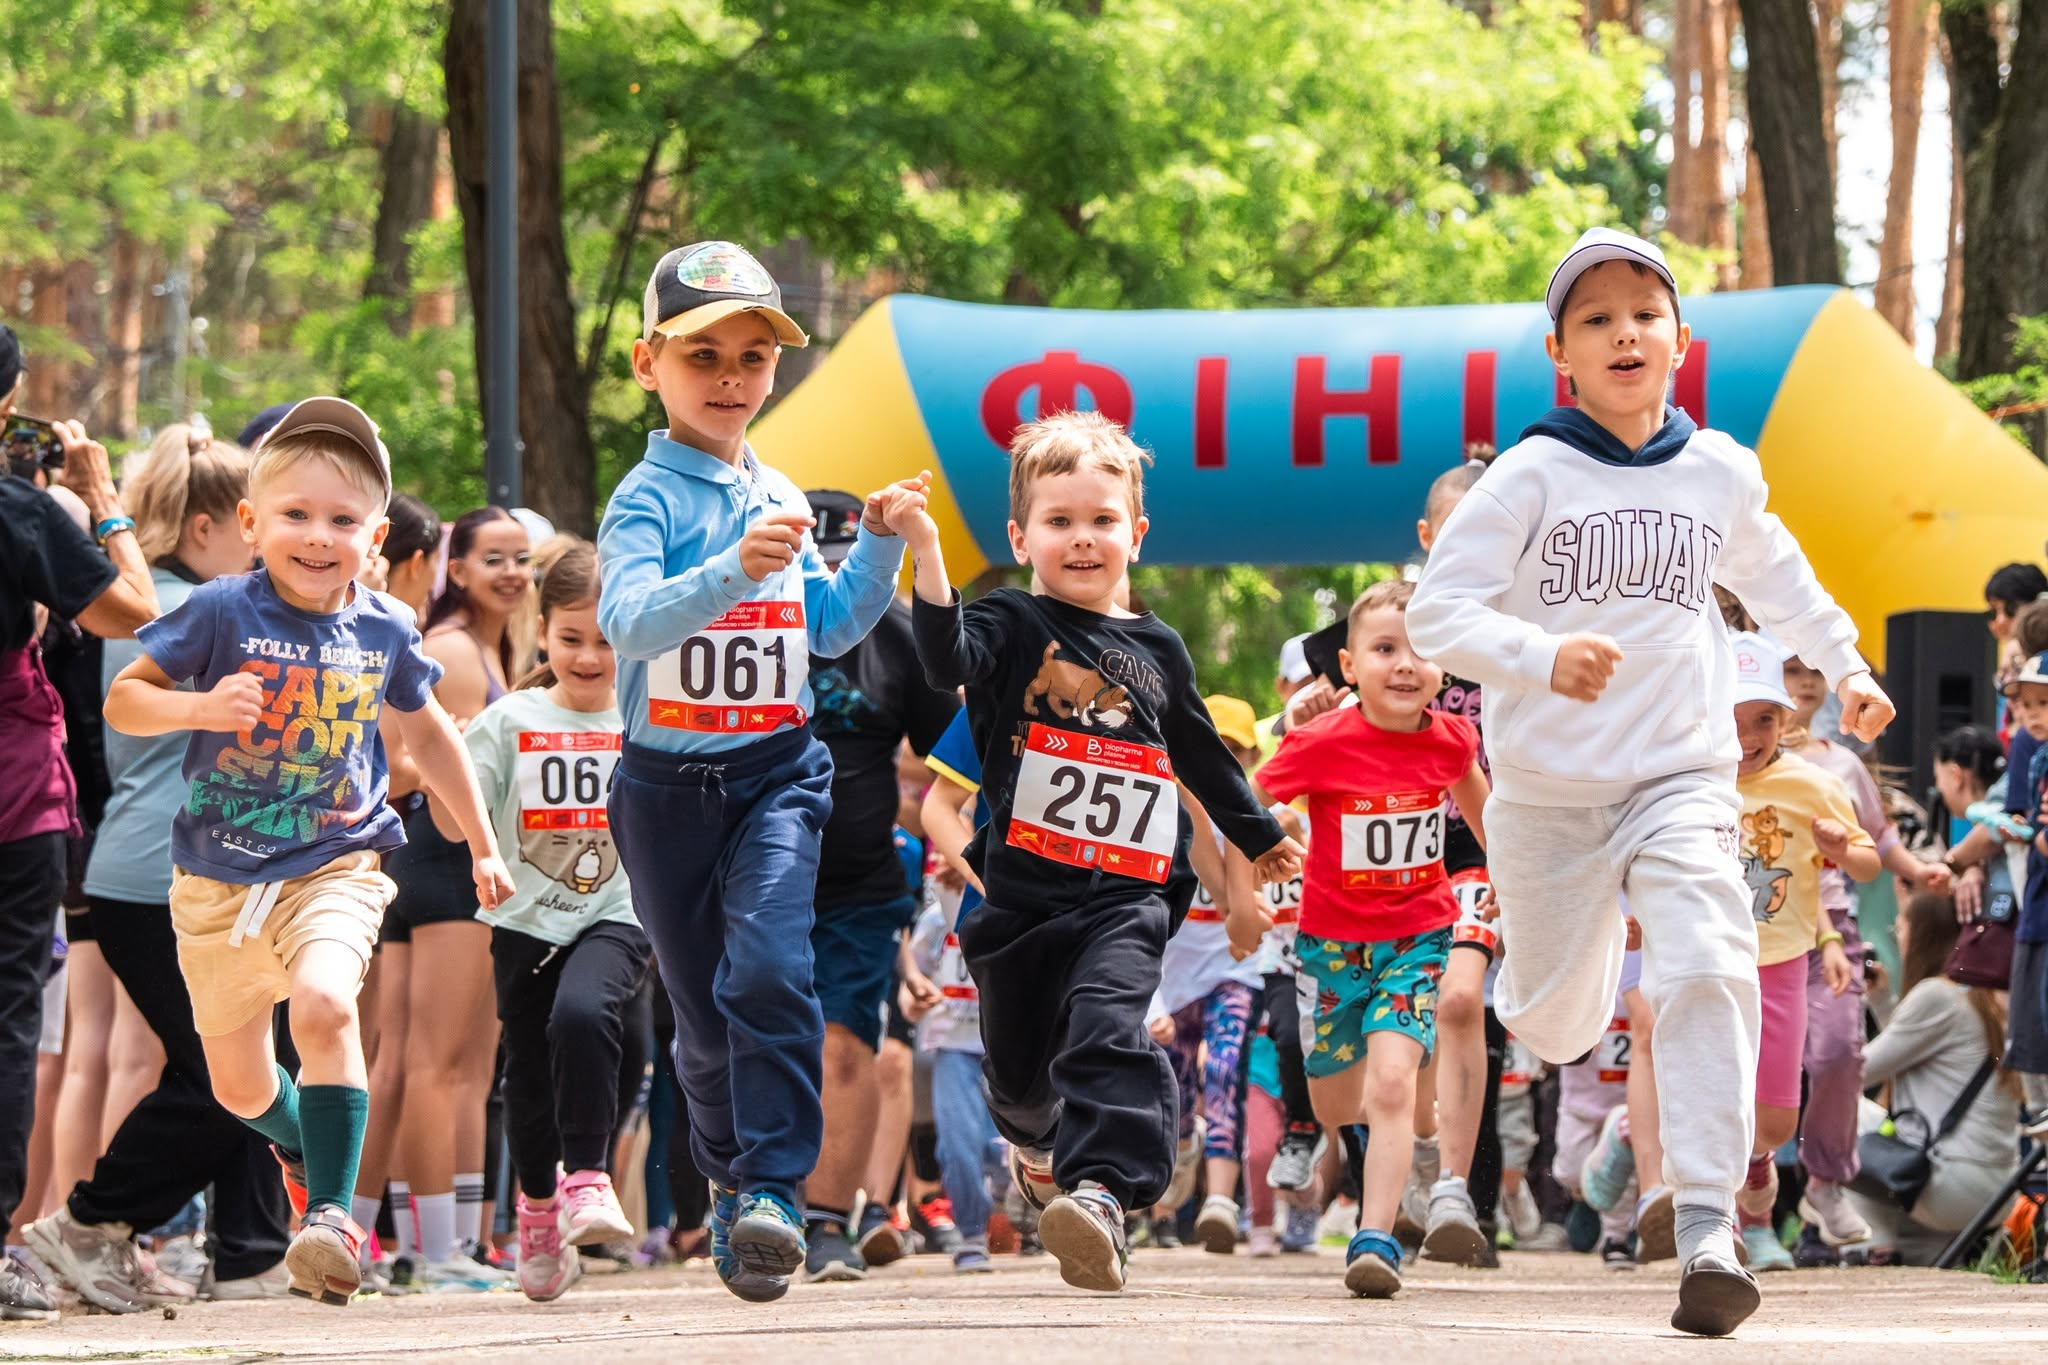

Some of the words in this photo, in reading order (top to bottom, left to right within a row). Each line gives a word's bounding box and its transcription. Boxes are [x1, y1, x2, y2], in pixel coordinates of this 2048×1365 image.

[680, 635, 787, 701] 061
[1104, 743, 1143, 756] biopharma
[1042, 765, 1161, 844] 257
[211, 829, 253, 848] EAST
[1366, 812, 1440, 866] 073
